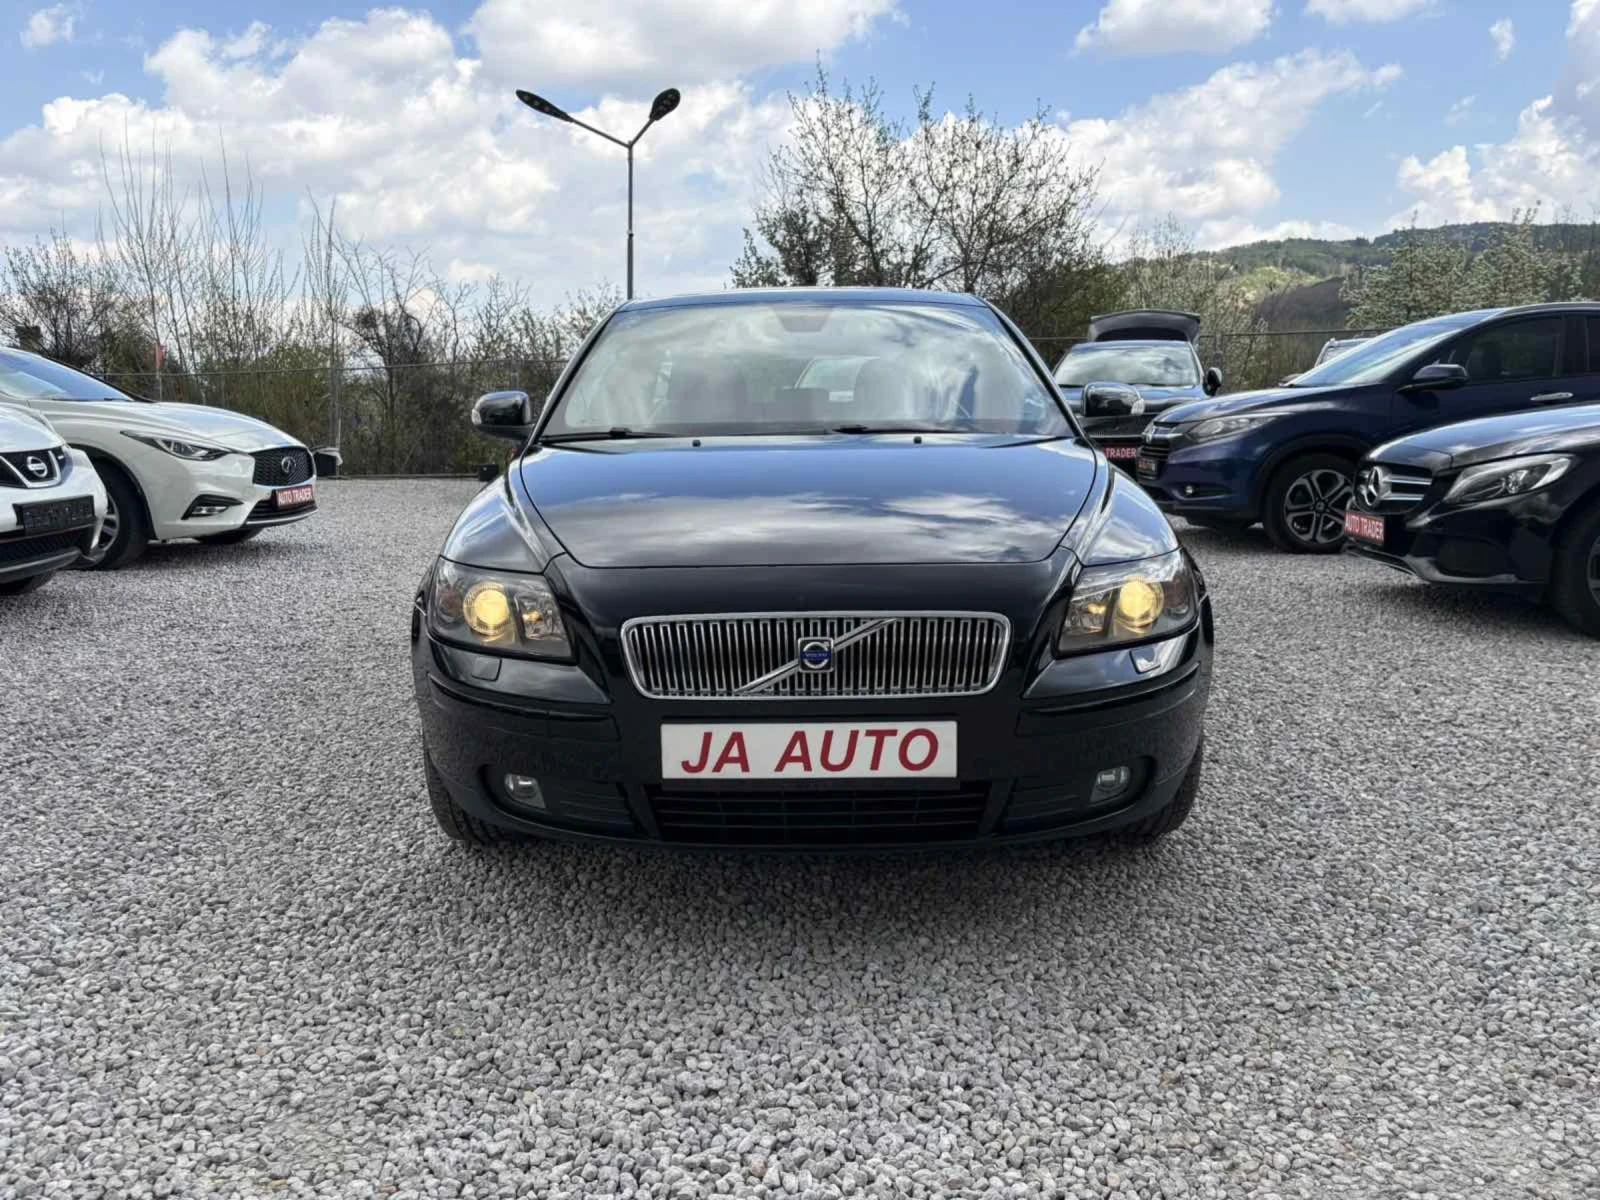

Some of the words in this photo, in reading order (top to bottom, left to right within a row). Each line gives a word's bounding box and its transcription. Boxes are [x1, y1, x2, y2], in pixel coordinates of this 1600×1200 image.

[1105, 447, 1137, 459] TRADER
[278, 490, 292, 505] AUTO
[292, 487, 313, 503] TRADER
[1345, 512, 1360, 533] AUTO
[1360, 517, 1384, 540] TRADER
[681, 731, 750, 773] JA
[774, 728, 939, 772] AUTO
